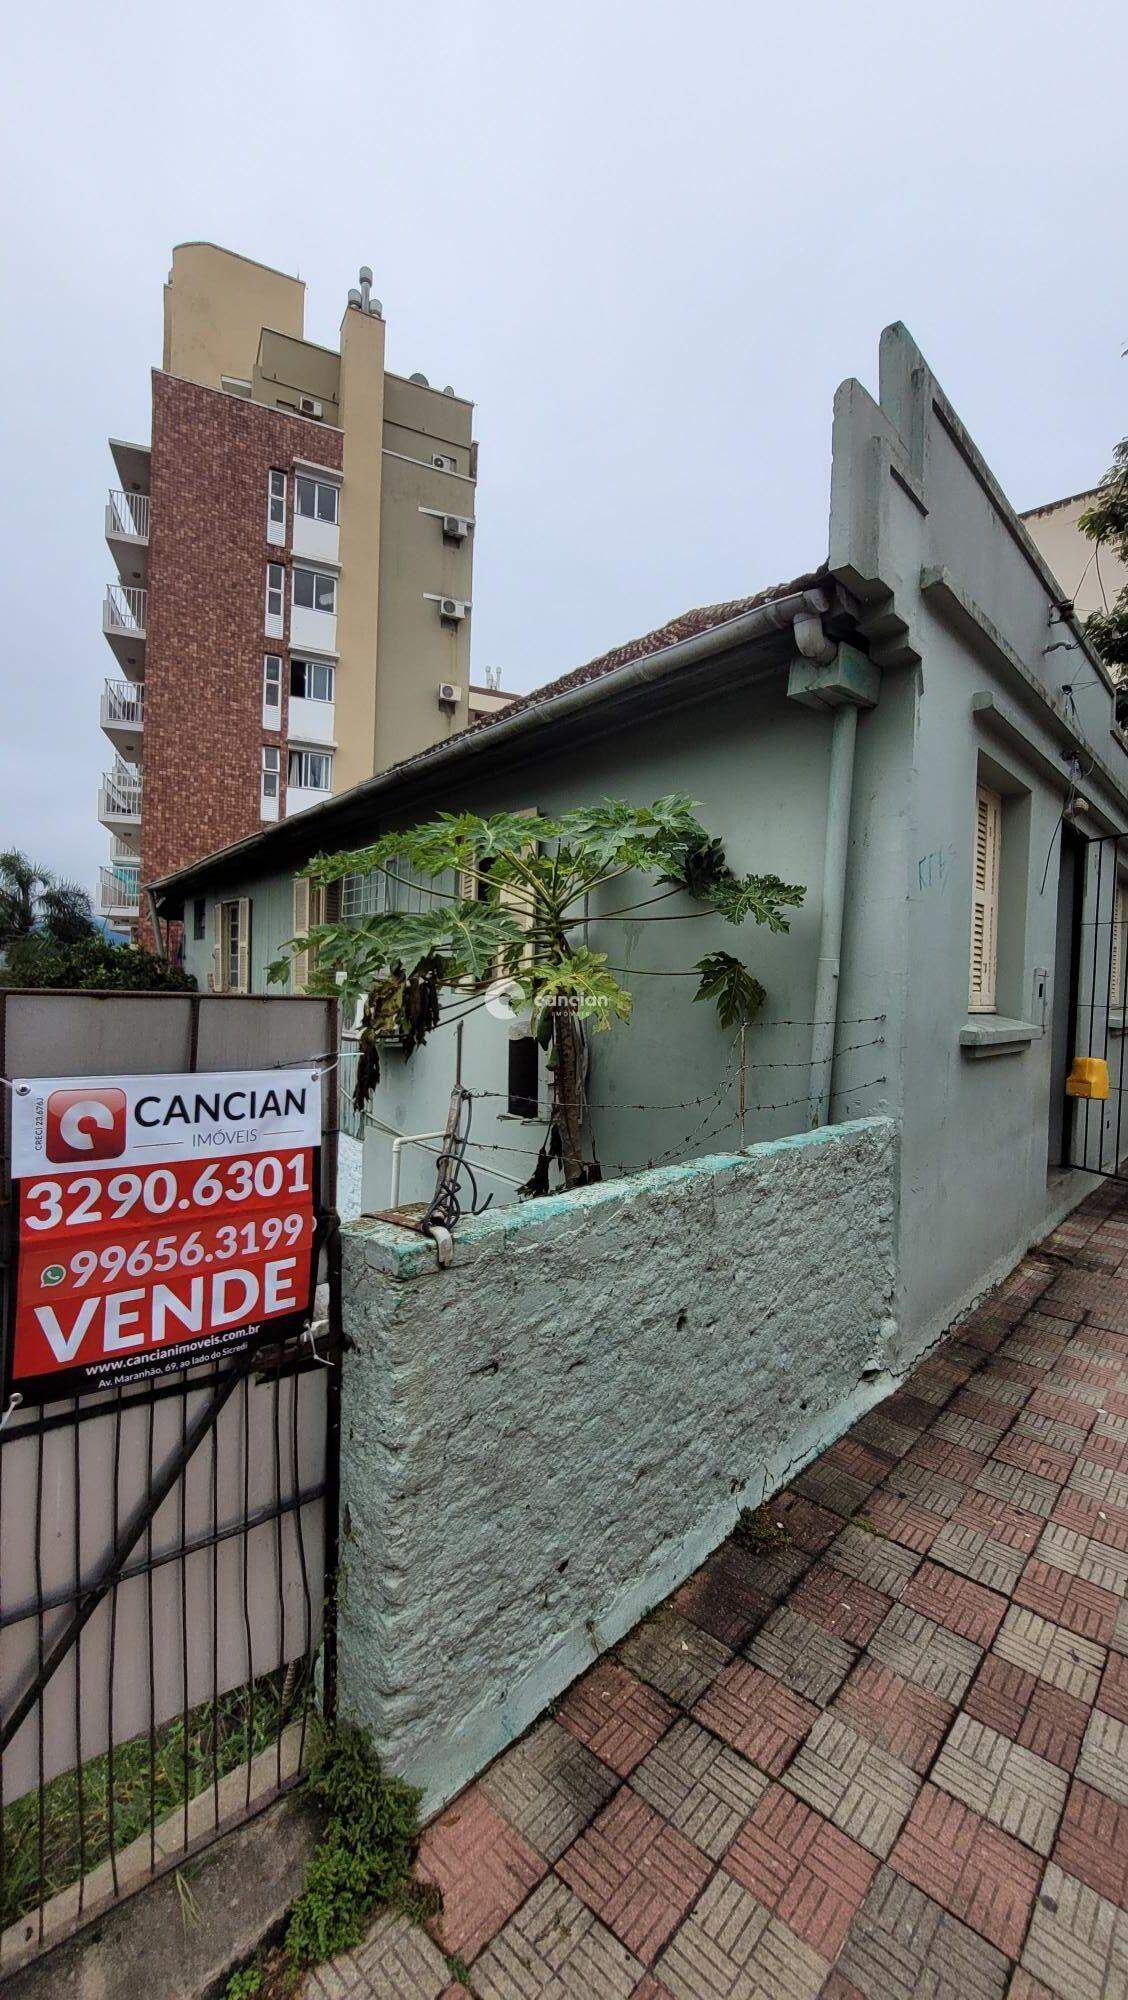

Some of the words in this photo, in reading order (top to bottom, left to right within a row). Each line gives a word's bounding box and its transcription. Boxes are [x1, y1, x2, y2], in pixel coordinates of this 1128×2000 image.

[134, 1088, 307, 1128] CANCIAN
[35, 1127, 43, 1151] CRECI
[192, 1128, 258, 1147] IMÓVEIS
[25, 1153, 310, 1231] 3290.6301
[70, 1213, 304, 1288] 99656.3199
[34, 1257, 297, 1363] VENDE
[85, 1324, 261, 1376] www.cancianimoveis.com.br
[98, 1379, 113, 1389] Av.
[114, 1366, 162, 1385] Maranhão,
[180, 1359, 190, 1368] ao
[191, 1353, 210, 1366] lado
[211, 1349, 221, 1359] do
[222, 1341, 249, 1356] Sicredi
